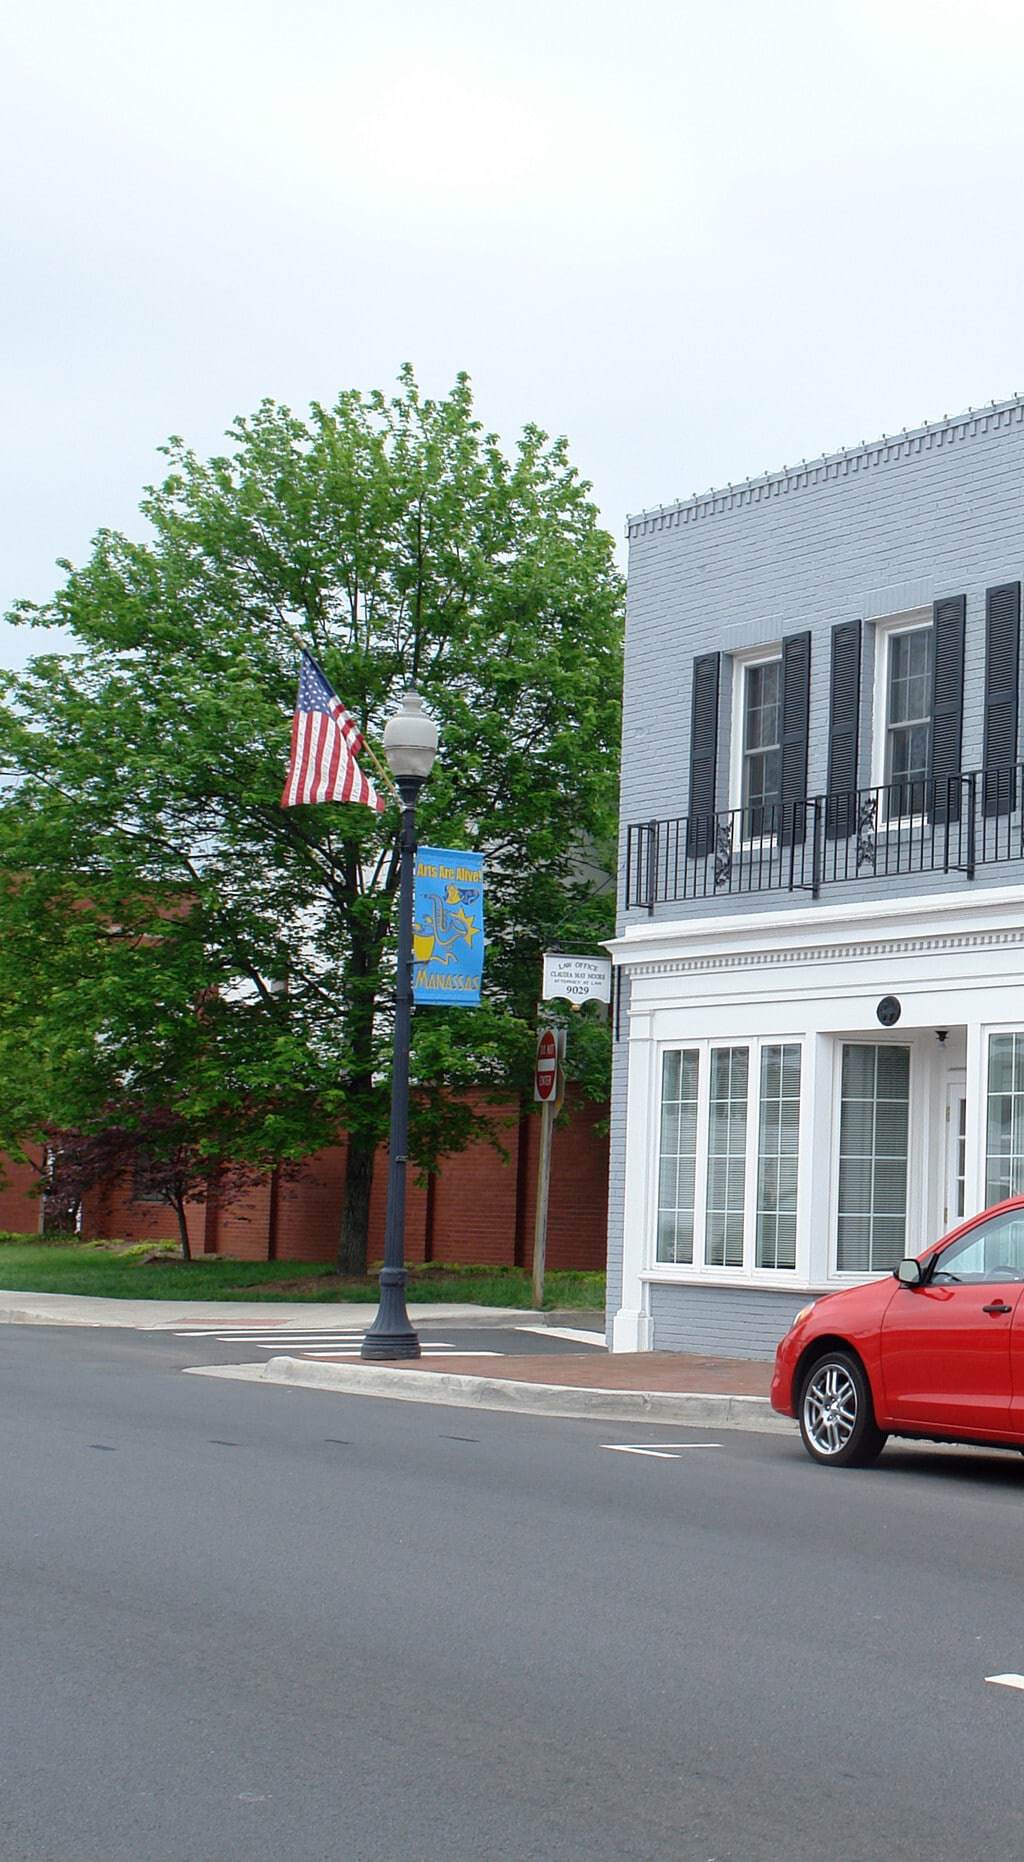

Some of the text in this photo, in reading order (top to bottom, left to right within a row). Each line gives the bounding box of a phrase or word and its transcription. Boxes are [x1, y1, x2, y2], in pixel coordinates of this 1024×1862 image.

[417, 862, 482, 882] Arts Are Alive!
[558, 961, 599, 971] LAW OFFICE
[415, 969, 481, 992] MANASSAS
[566, 986, 590, 995] 9029
